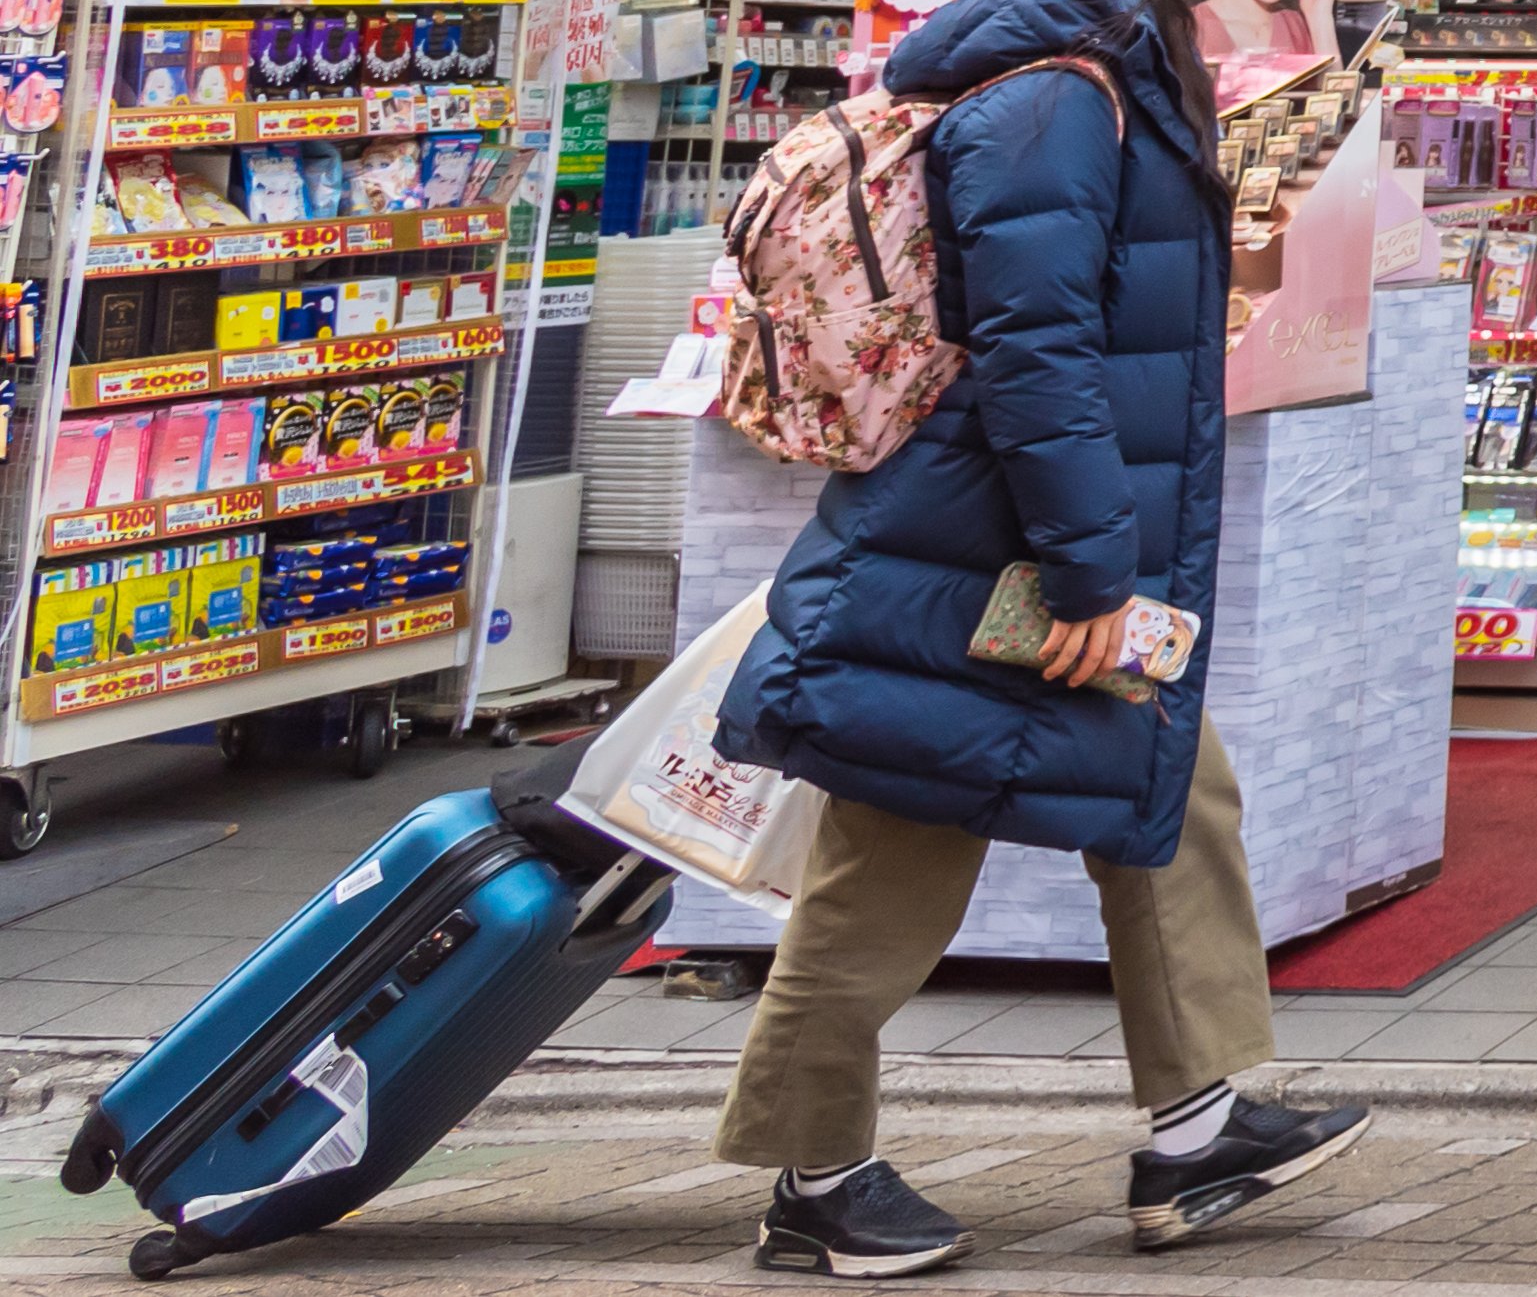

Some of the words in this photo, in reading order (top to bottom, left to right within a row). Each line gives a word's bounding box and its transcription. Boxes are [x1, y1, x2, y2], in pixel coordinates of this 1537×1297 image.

[149, 237, 212, 259] 380
[281, 226, 339, 247] 380
[451, 324, 502, 346] 1600
[314, 339, 396, 363] 1500
[130, 370, 207, 390] 2000
[215, 490, 263, 516] 1500
[106, 507, 155, 531] 1200
[403, 610, 453, 631] 1300
[307, 628, 367, 646] 1300
[188, 650, 258, 676] 2038
[84, 672, 156, 699] 2038
